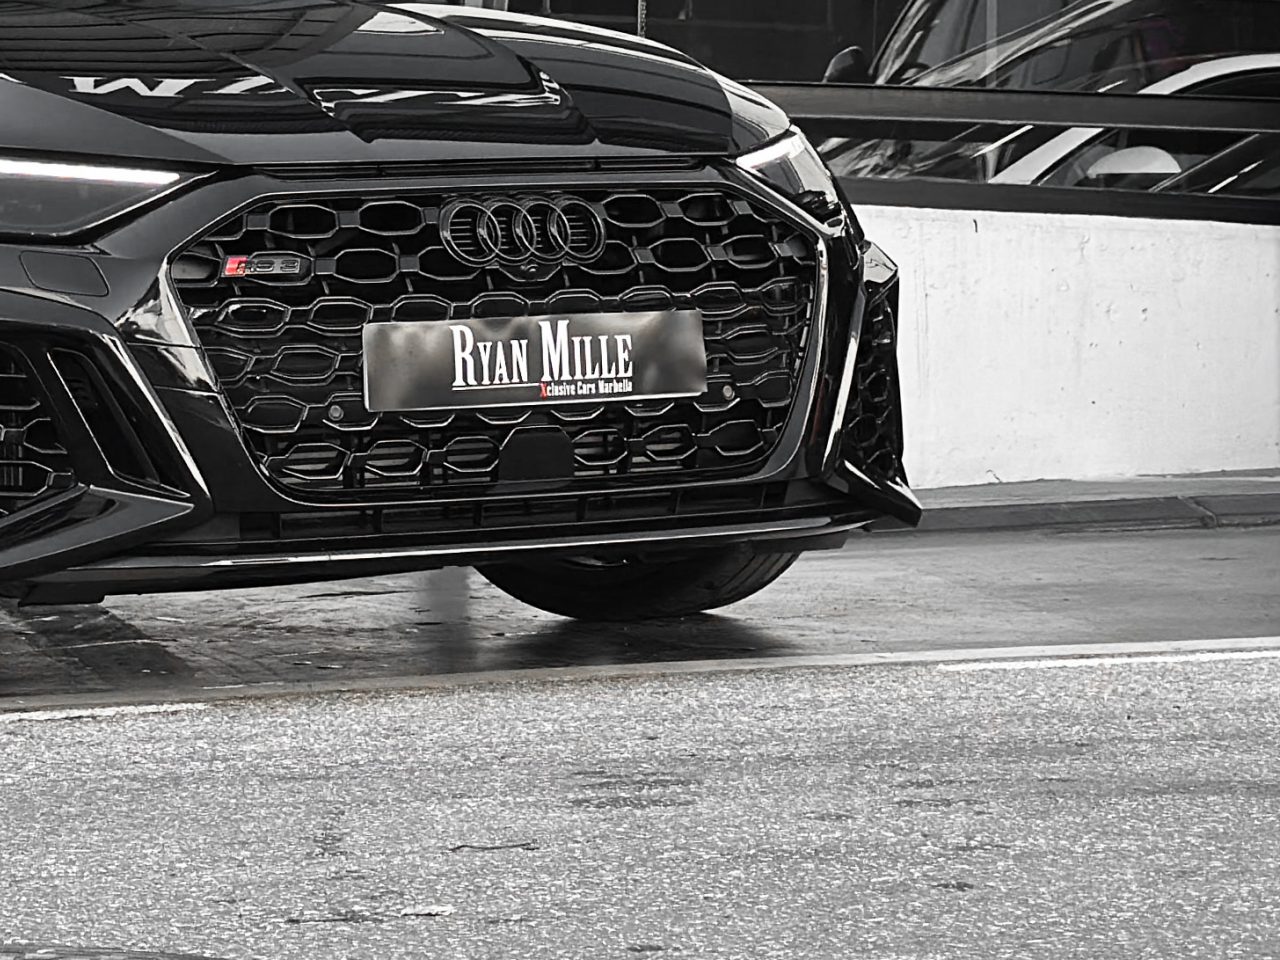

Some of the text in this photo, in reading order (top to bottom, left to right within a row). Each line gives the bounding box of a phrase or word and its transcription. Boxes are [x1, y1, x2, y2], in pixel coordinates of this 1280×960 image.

[449, 319, 633, 388] RYAN MILLE
[577, 381, 596, 394] Cars
